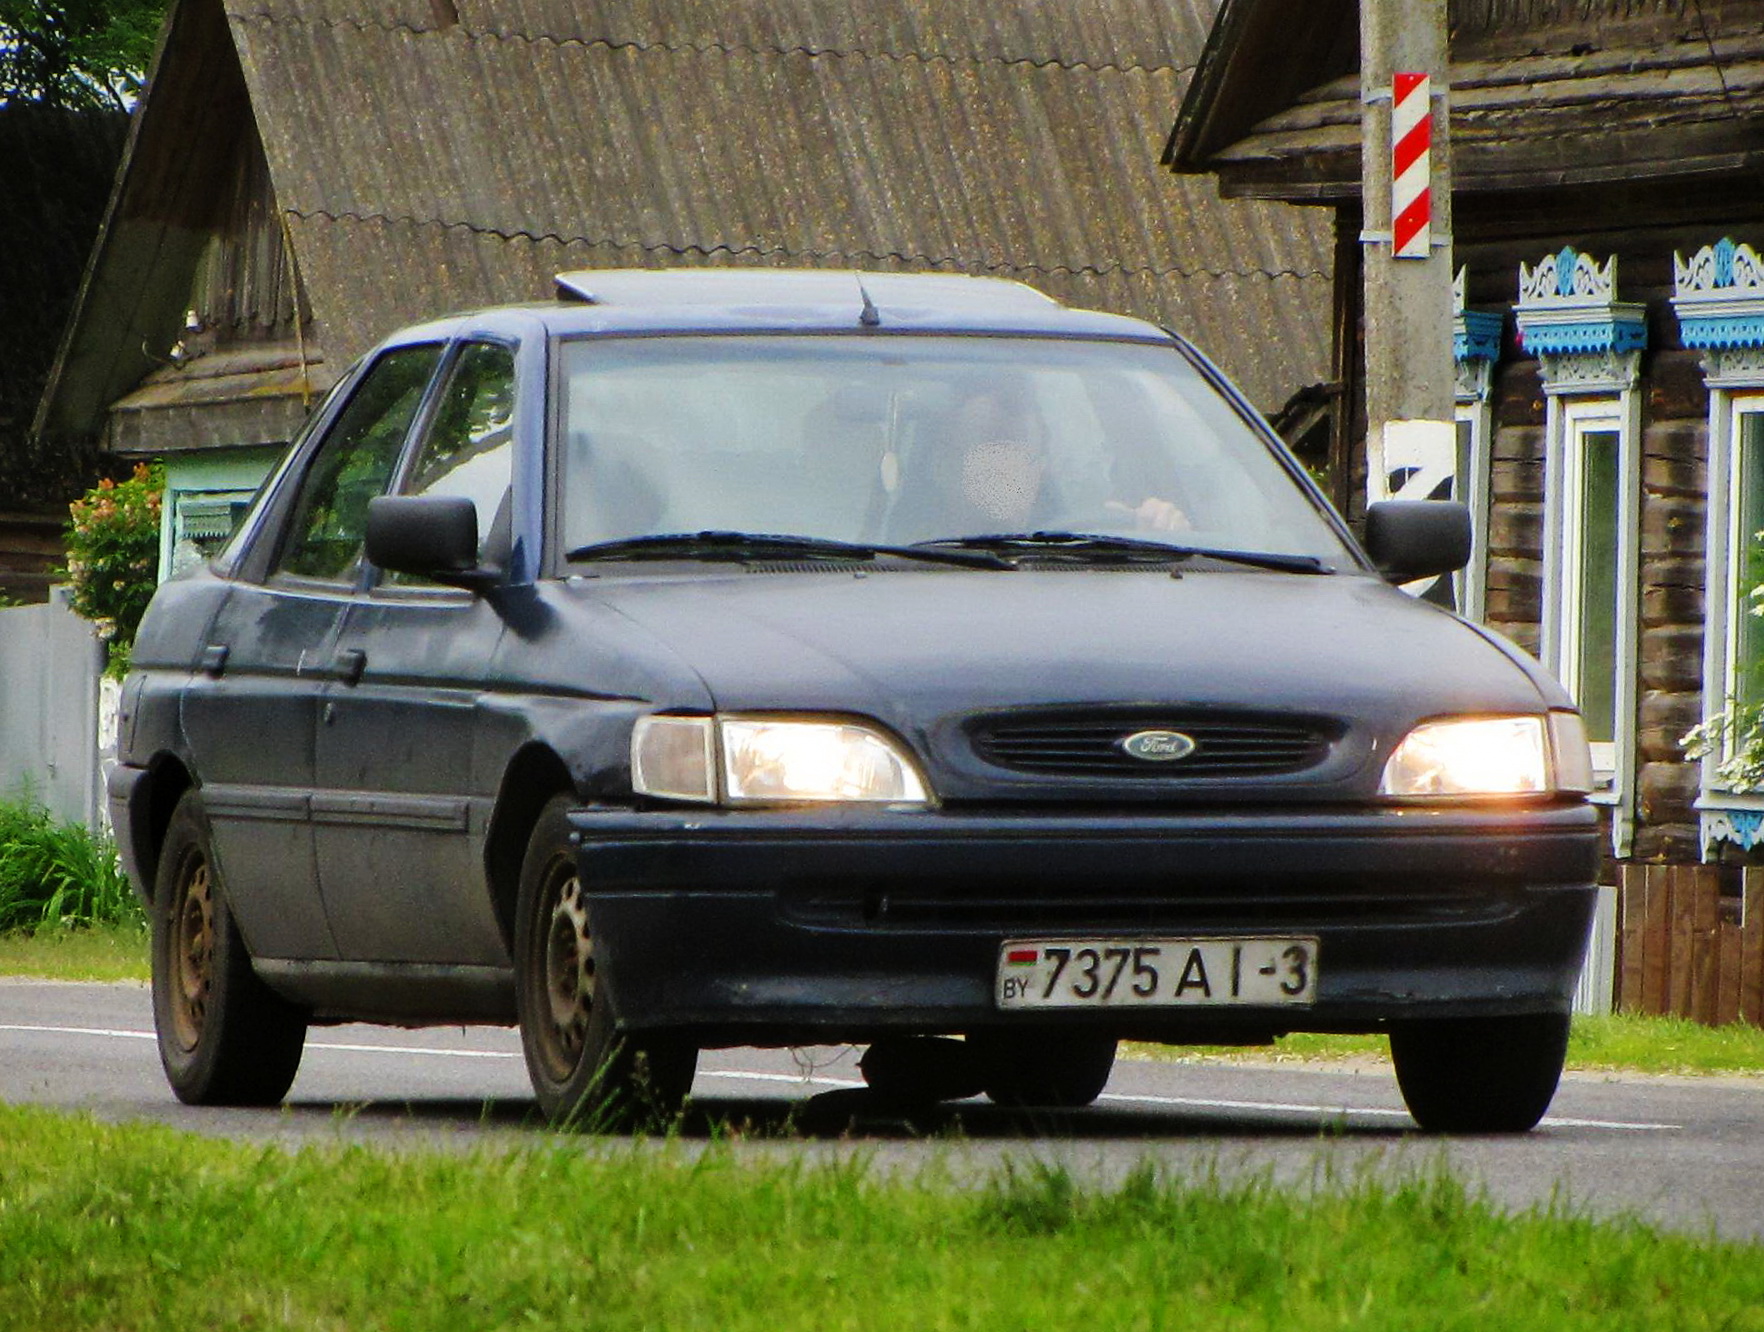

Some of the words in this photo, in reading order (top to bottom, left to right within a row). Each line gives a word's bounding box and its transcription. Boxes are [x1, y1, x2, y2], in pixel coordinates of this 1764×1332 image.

[1140, 736, 1178, 753] Ford
[1043, 947, 1161, 999] 7375
[1002, 979, 1029, 999] BY
